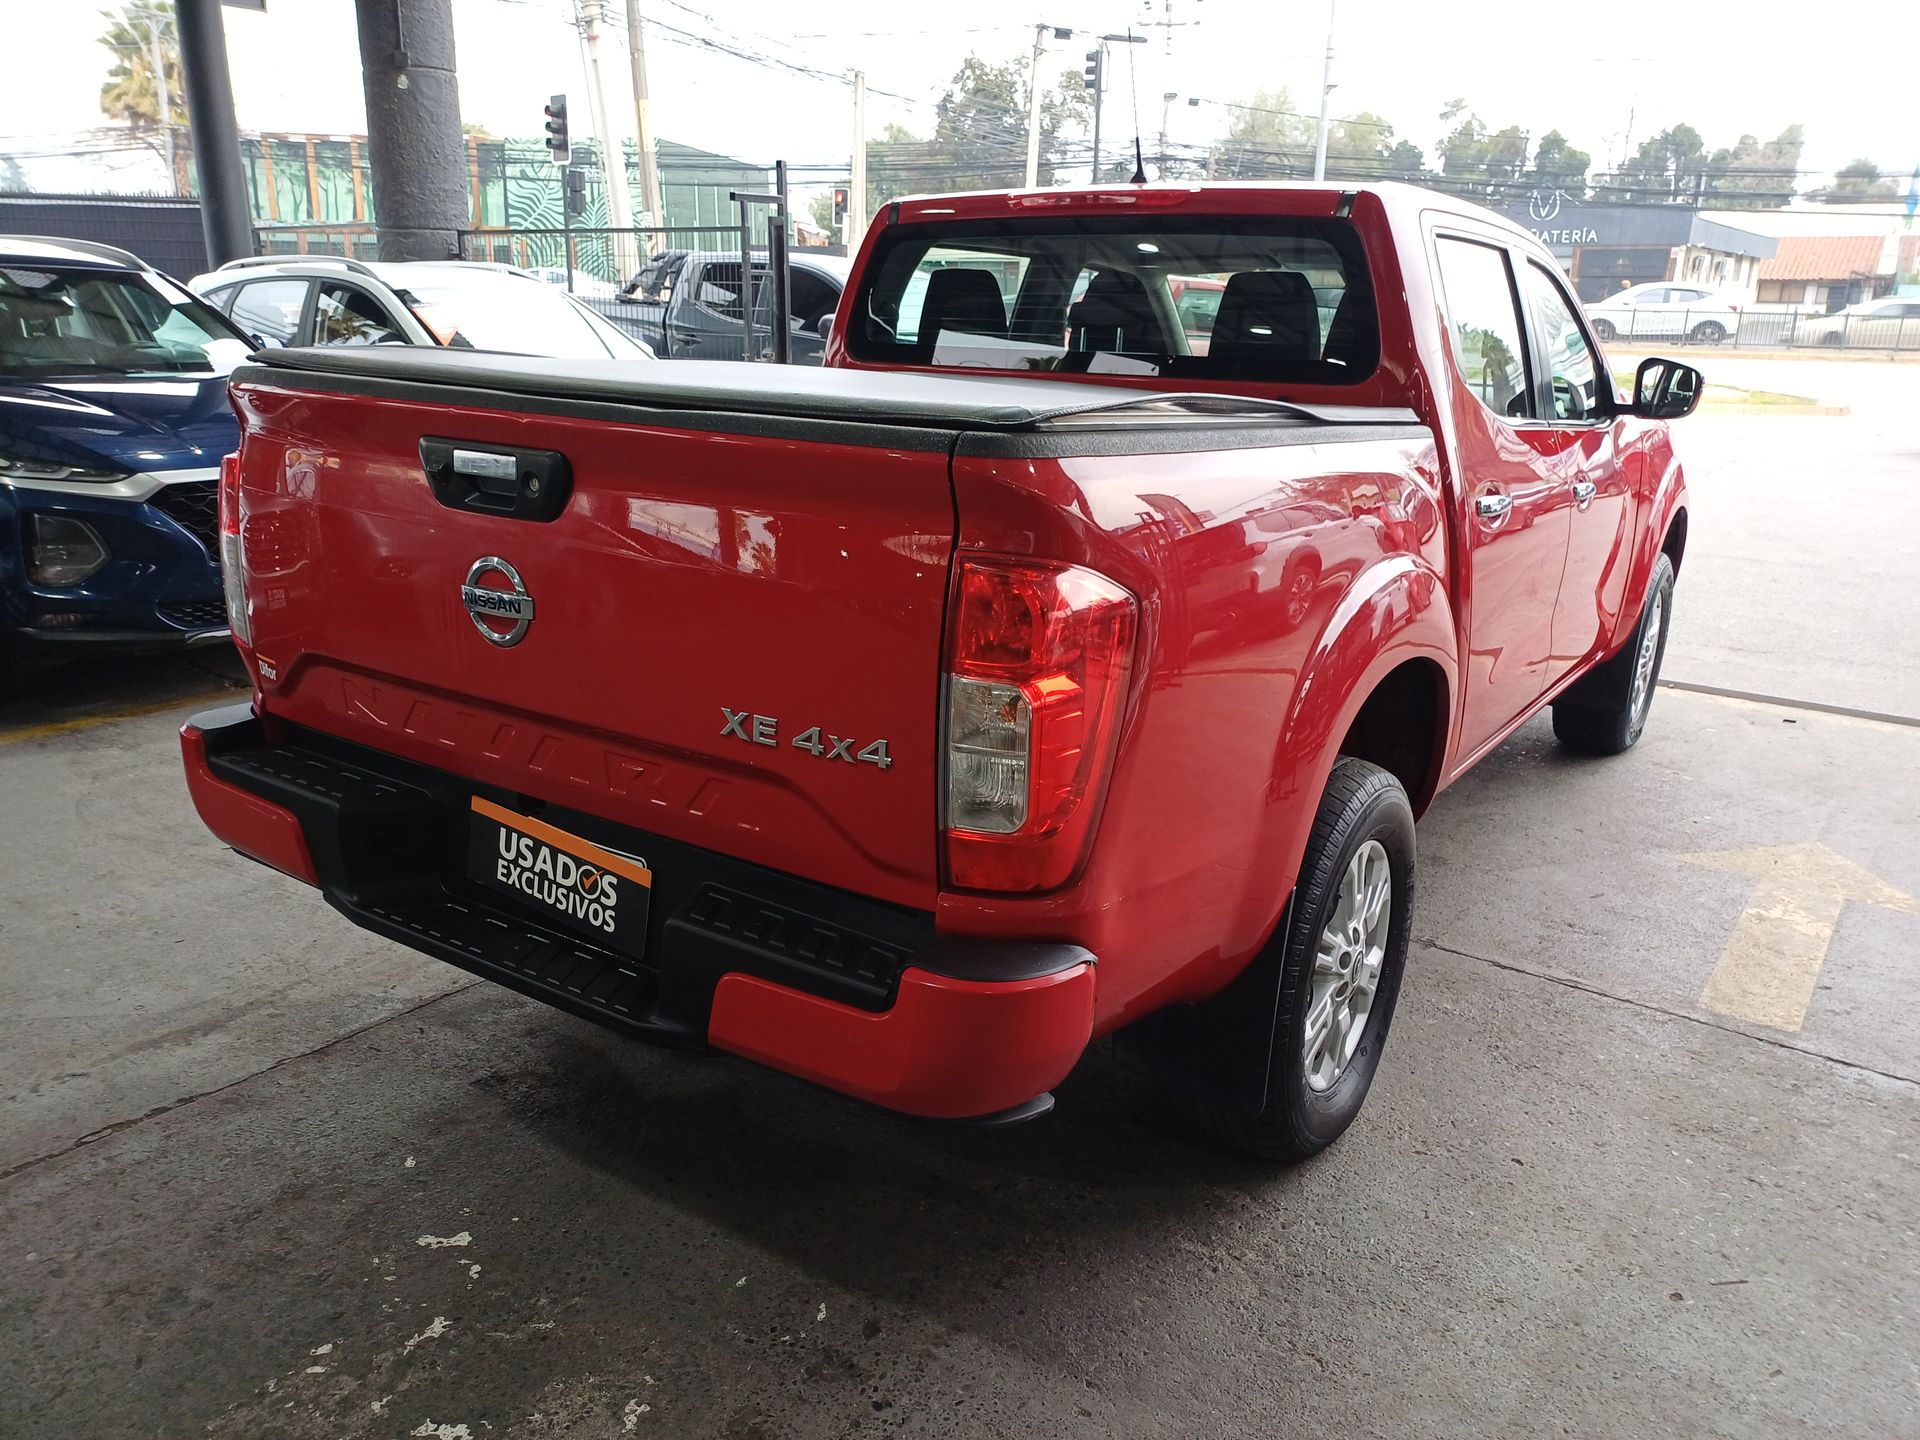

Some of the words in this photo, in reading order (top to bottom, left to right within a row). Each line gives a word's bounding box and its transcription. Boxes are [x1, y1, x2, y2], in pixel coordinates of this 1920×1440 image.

[464, 591, 521, 615] NISSAN
[719, 707, 778, 747] XE
[791, 726, 892, 769] 4x4
[496, 858, 616, 933] EXCLUSIVOS
[499, 826, 618, 907] USADOS
